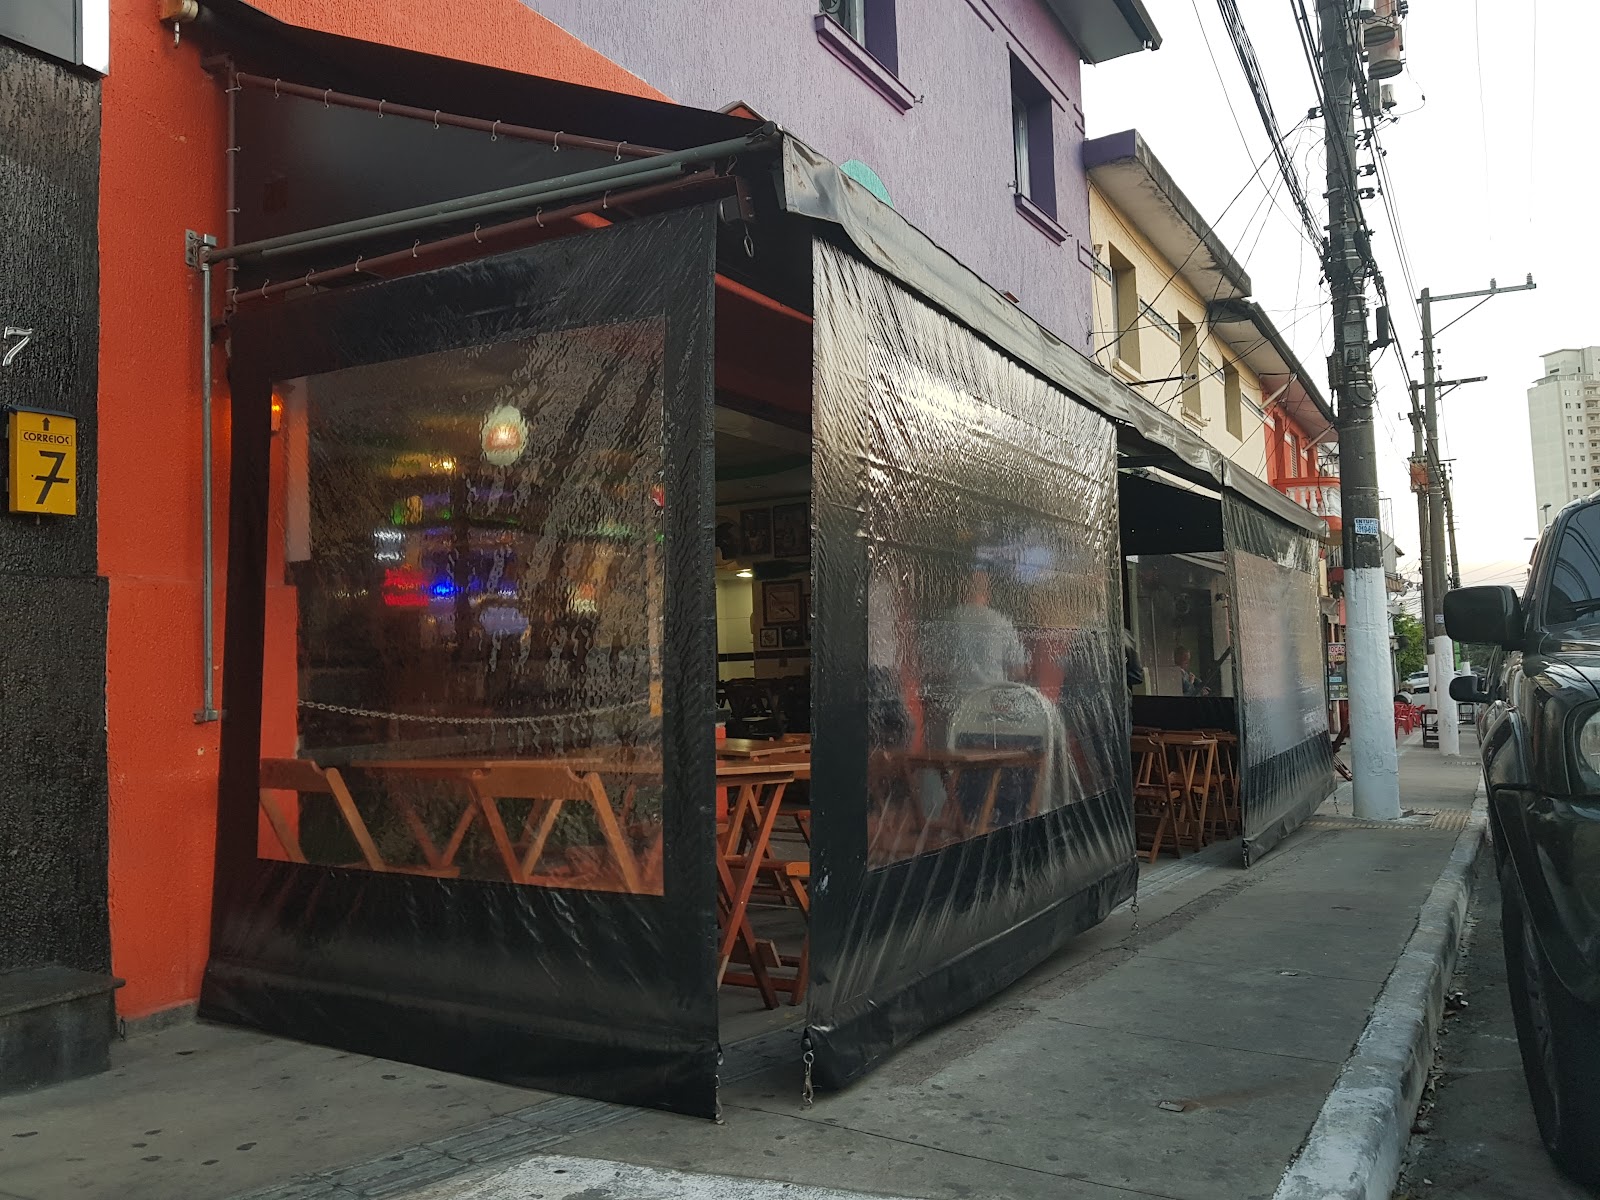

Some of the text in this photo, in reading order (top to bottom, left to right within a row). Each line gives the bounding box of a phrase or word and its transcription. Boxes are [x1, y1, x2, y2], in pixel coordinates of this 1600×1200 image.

[3, 326, 33, 366] 7
[23, 431, 70, 445] CORREIOS
[34, 450, 70, 505] 7
